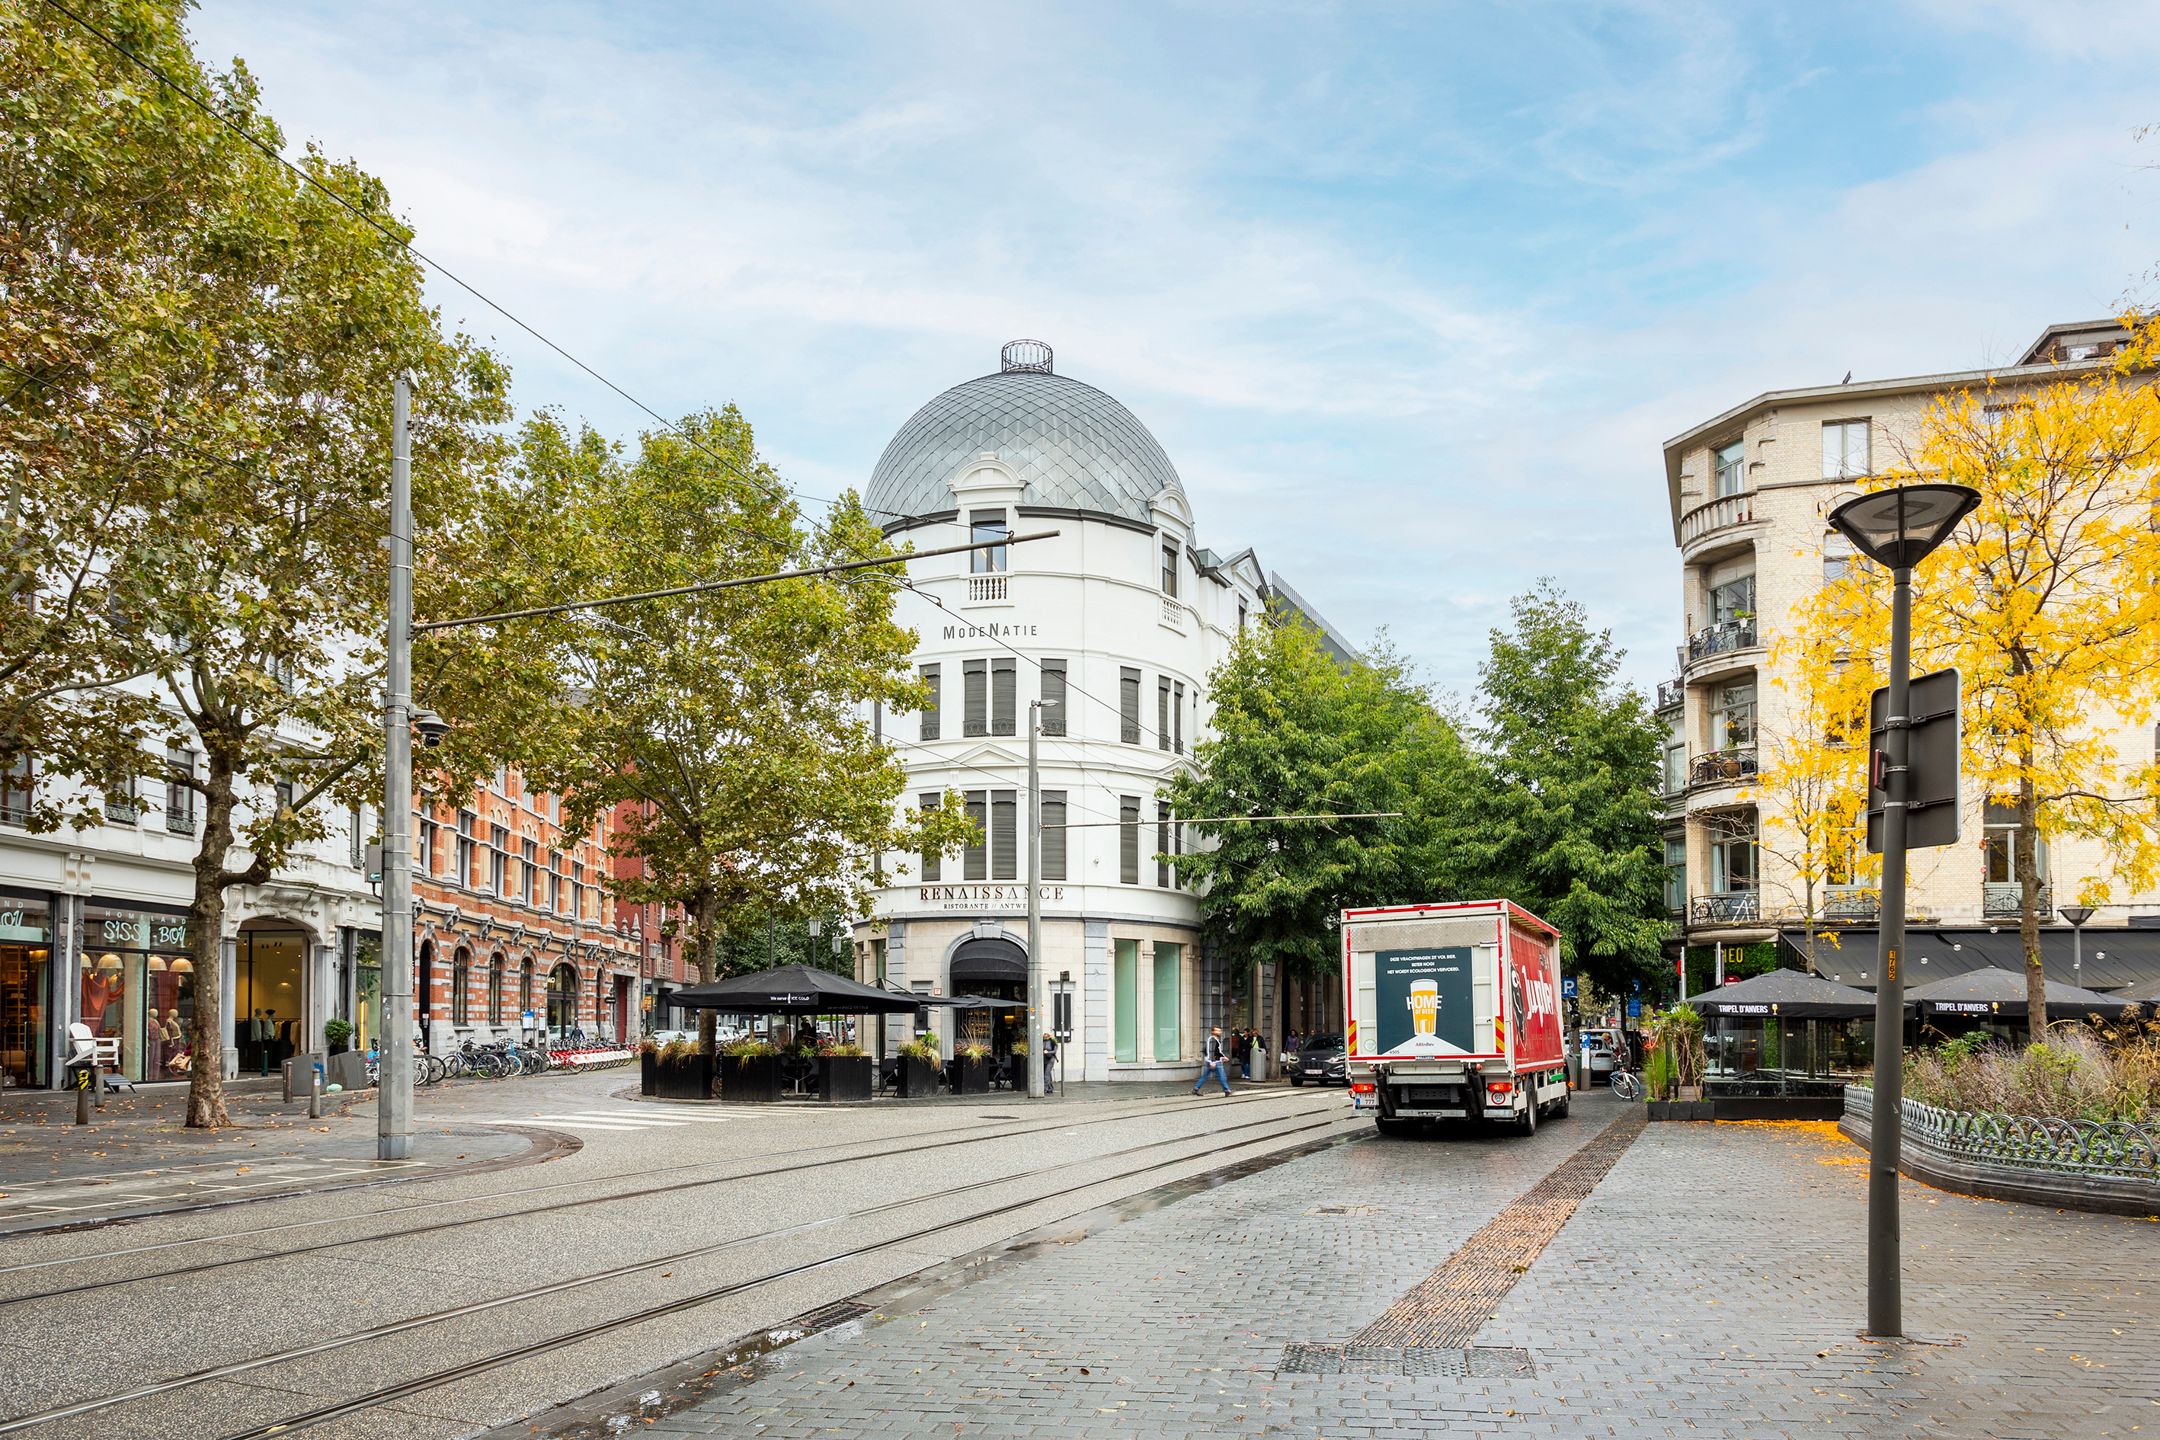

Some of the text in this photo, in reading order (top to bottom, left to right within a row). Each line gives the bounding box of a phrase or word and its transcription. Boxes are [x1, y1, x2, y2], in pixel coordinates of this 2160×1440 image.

[105, 910, 187, 925] HOMELAND
[1888, 951, 1896, 980] 1762
[1563, 980, 1575, 994] P
[1406, 995, 1443, 1010] HOME
[1719, 1005, 1768, 1013] TRIPEL D'ANVERS
[1935, 1002, 1988, 1012] TRIPEL D'ANVERS
[1582, 1034, 1588, 1042] P
